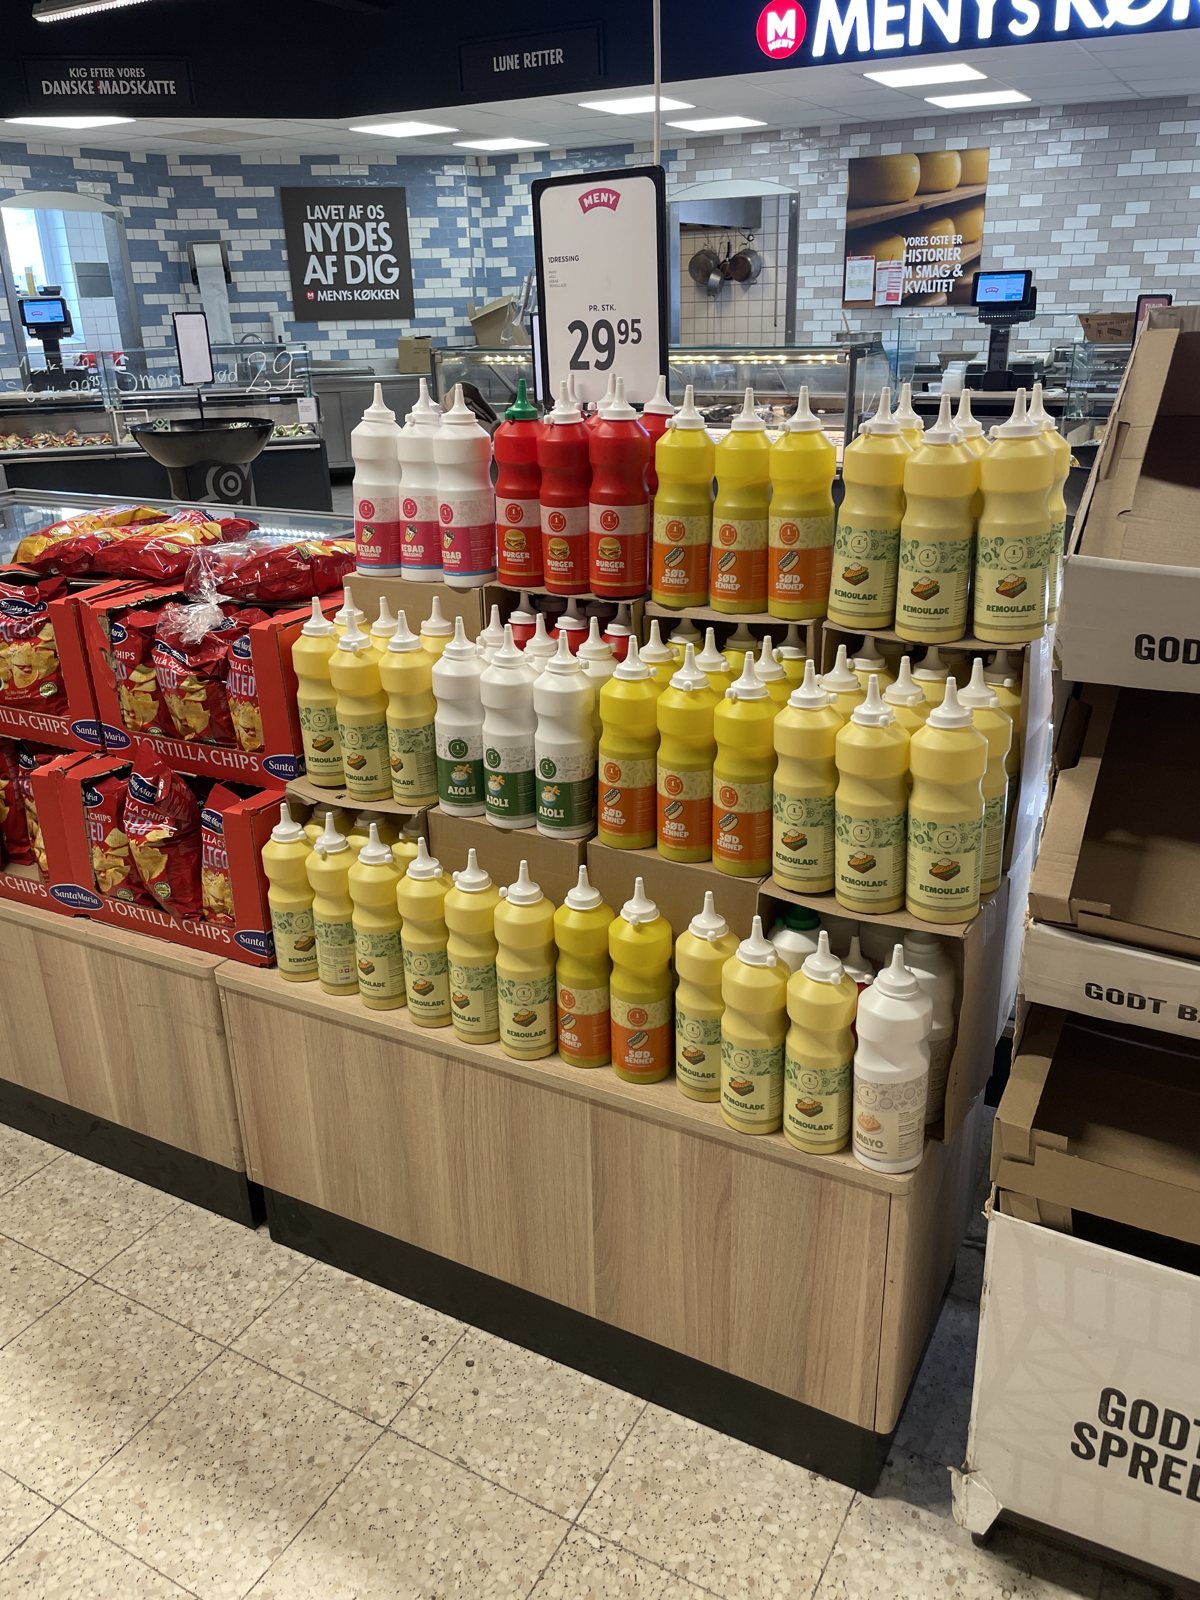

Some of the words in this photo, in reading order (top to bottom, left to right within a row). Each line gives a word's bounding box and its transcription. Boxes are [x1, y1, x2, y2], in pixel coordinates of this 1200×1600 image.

[767, 9, 796, 42] M
[493, 54, 520, 72] LUNE
[523, 48, 564, 69] RETTER
[69, 67, 88, 78] KIG
[90, 67, 115, 78] EFTER
[117, 67, 146, 78] VORES
[41, 80, 95, 95] DANSKE
[99, 80, 176, 95] MADSKATTE
[583, 192, 617, 208] MENY
[306, 204, 344, 220] LAVET
[348, 205, 364, 220] AF
[367, 204, 385, 220] OS
[303, 221, 393, 252] NYDES
[903, 236, 928, 247] VORES
[930, 236, 948, 246] OSTE
[952, 234, 963, 245] ER
[903, 247, 962, 263] HISTORIER
[304, 254, 338, 285] AF
[344, 254, 400, 284] DIG
[916, 264, 952, 279] SMAG
[953, 263, 964, 277] &
[904, 279, 955, 294] KVALITET
[354, 289, 400, 300] KØKKEN
[358, 544, 382, 554] KEBAB
[401, 544, 424, 554] KEBAB
[502, 550, 530, 559] BURGER
[547, 559, 574, 568] BURGER
[595, 560, 625, 569] BURGER
[665, 569, 686, 578] SØD
[717, 573, 737, 583] SØD
[778, 573, 800, 583] SØD
[661, 576, 689, 585] SENNEP
[714, 581, 741, 591] SENNEP
[775, 582, 804, 591] SENNEP
[834, 588, 878, 601] REMOULADE
[902, 604, 950, 616] REMOULADE
[986, 603, 1037, 614] REMOULADE
[28, 716, 69, 736] CHIPS
[76, 725, 98, 736] Santa
[104, 731, 126, 743] Maria
[210, 750, 260, 772] CHIPS
[268, 760, 295, 772] Santa
[308, 756, 343, 764] REMOULAD
[447, 785, 476, 795] AIOLI
[486, 794, 509, 808] AIOLI
[90, 812, 111, 823] CHIPS
[140, 808, 170, 824] CHIPS
[538, 805, 565, 818] AIOLI
[604, 806, 623, 818] SØD
[601, 813, 626, 825] SENNEP
[665, 820, 686, 831] SØD
[662, 827, 689, 838] SENNEP
[719, 832, 740, 844] SØD
[716, 839, 744, 851] SENNEP
[775, 852, 819, 866] REMOULADE
[5, 876, 48, 898] CHIPS
[840, 874, 888, 888] REMOULADE
[919, 883, 970, 895] REMOULADE
[105, 899, 181, 931] TORTILLA
[182, 920, 231, 944] CHIPS
[239, 934, 265, 947] Santa
[409, 996, 446, 1007] REMOULADE
[1085, 982, 1168, 1014] GODT
[1178, 1003, 1200, 1024] B
[507, 1028, 547, 1038] REMOULADE
[624, 1056, 654, 1064] SENNEP
[628, 1050, 650, 1058] SØD
[677, 1062, 716, 1079] REMOULADE
[723, 1092, 765, 1111] REMOULADE
[788, 1114, 834, 1132] REMOULADE
[856, 1130, 884, 1149] MAYO
